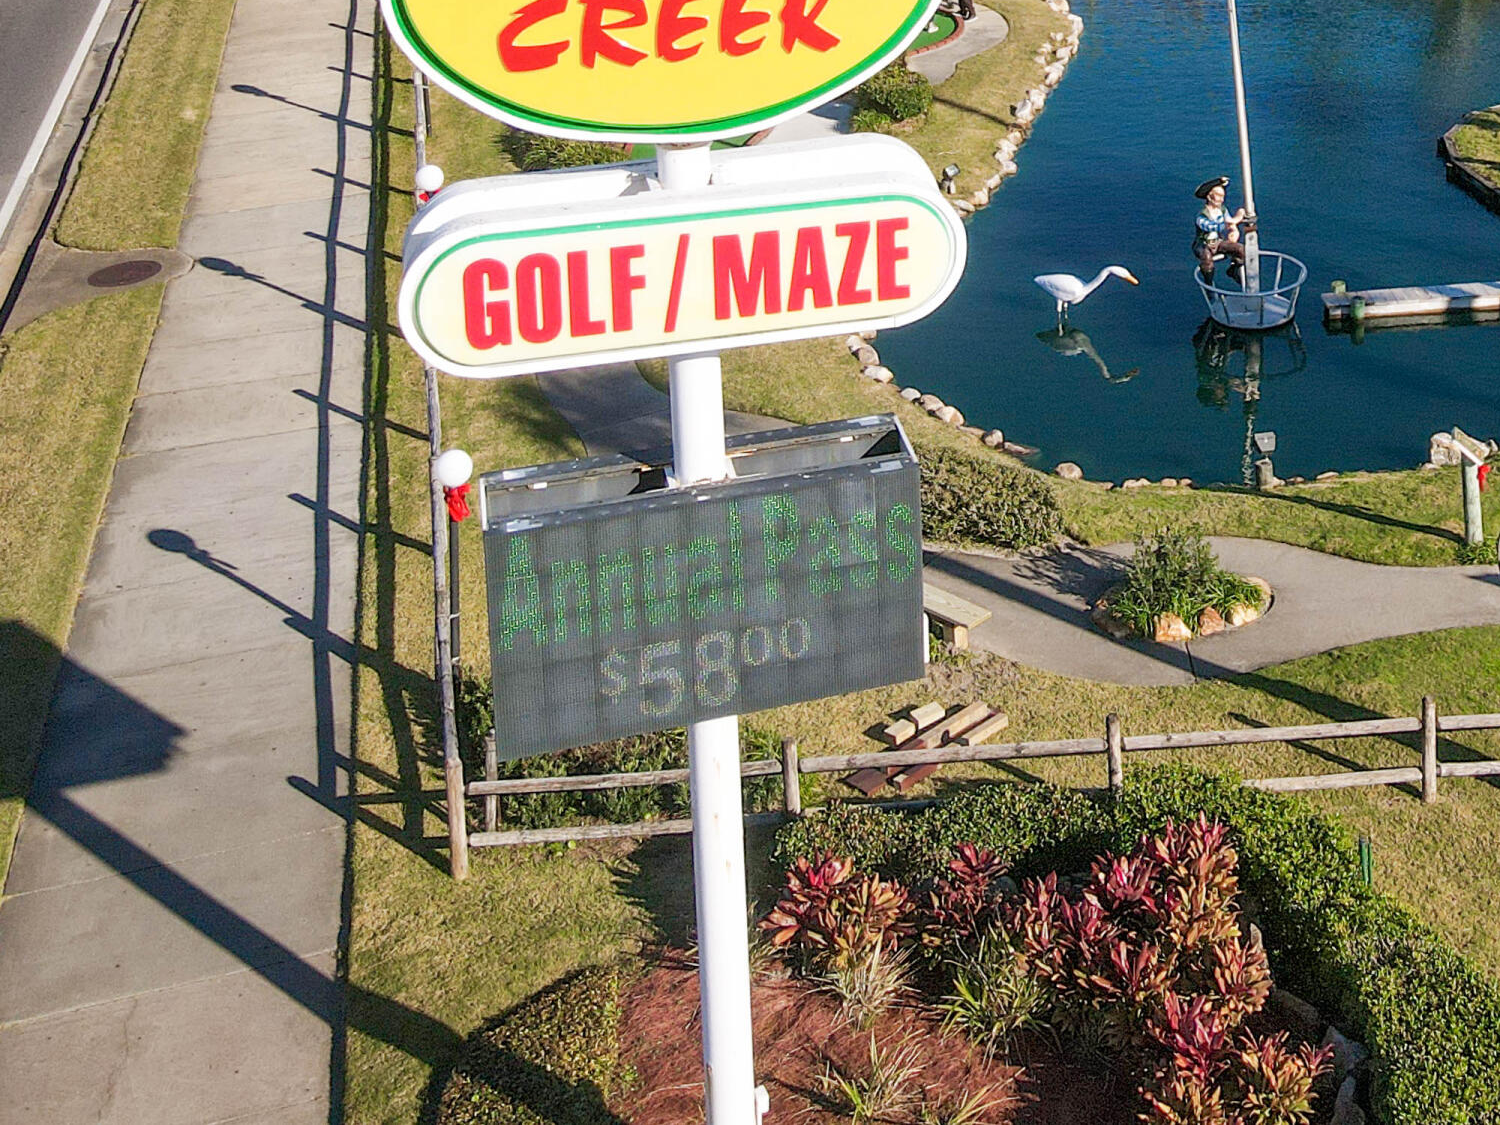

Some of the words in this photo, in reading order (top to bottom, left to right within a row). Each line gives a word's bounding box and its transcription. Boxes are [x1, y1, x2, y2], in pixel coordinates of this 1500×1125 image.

[462, 243, 647, 351] GOLF
[712, 217, 911, 321] MAZE
[501, 500, 745, 649] Annual
[763, 494, 915, 596] Pass
